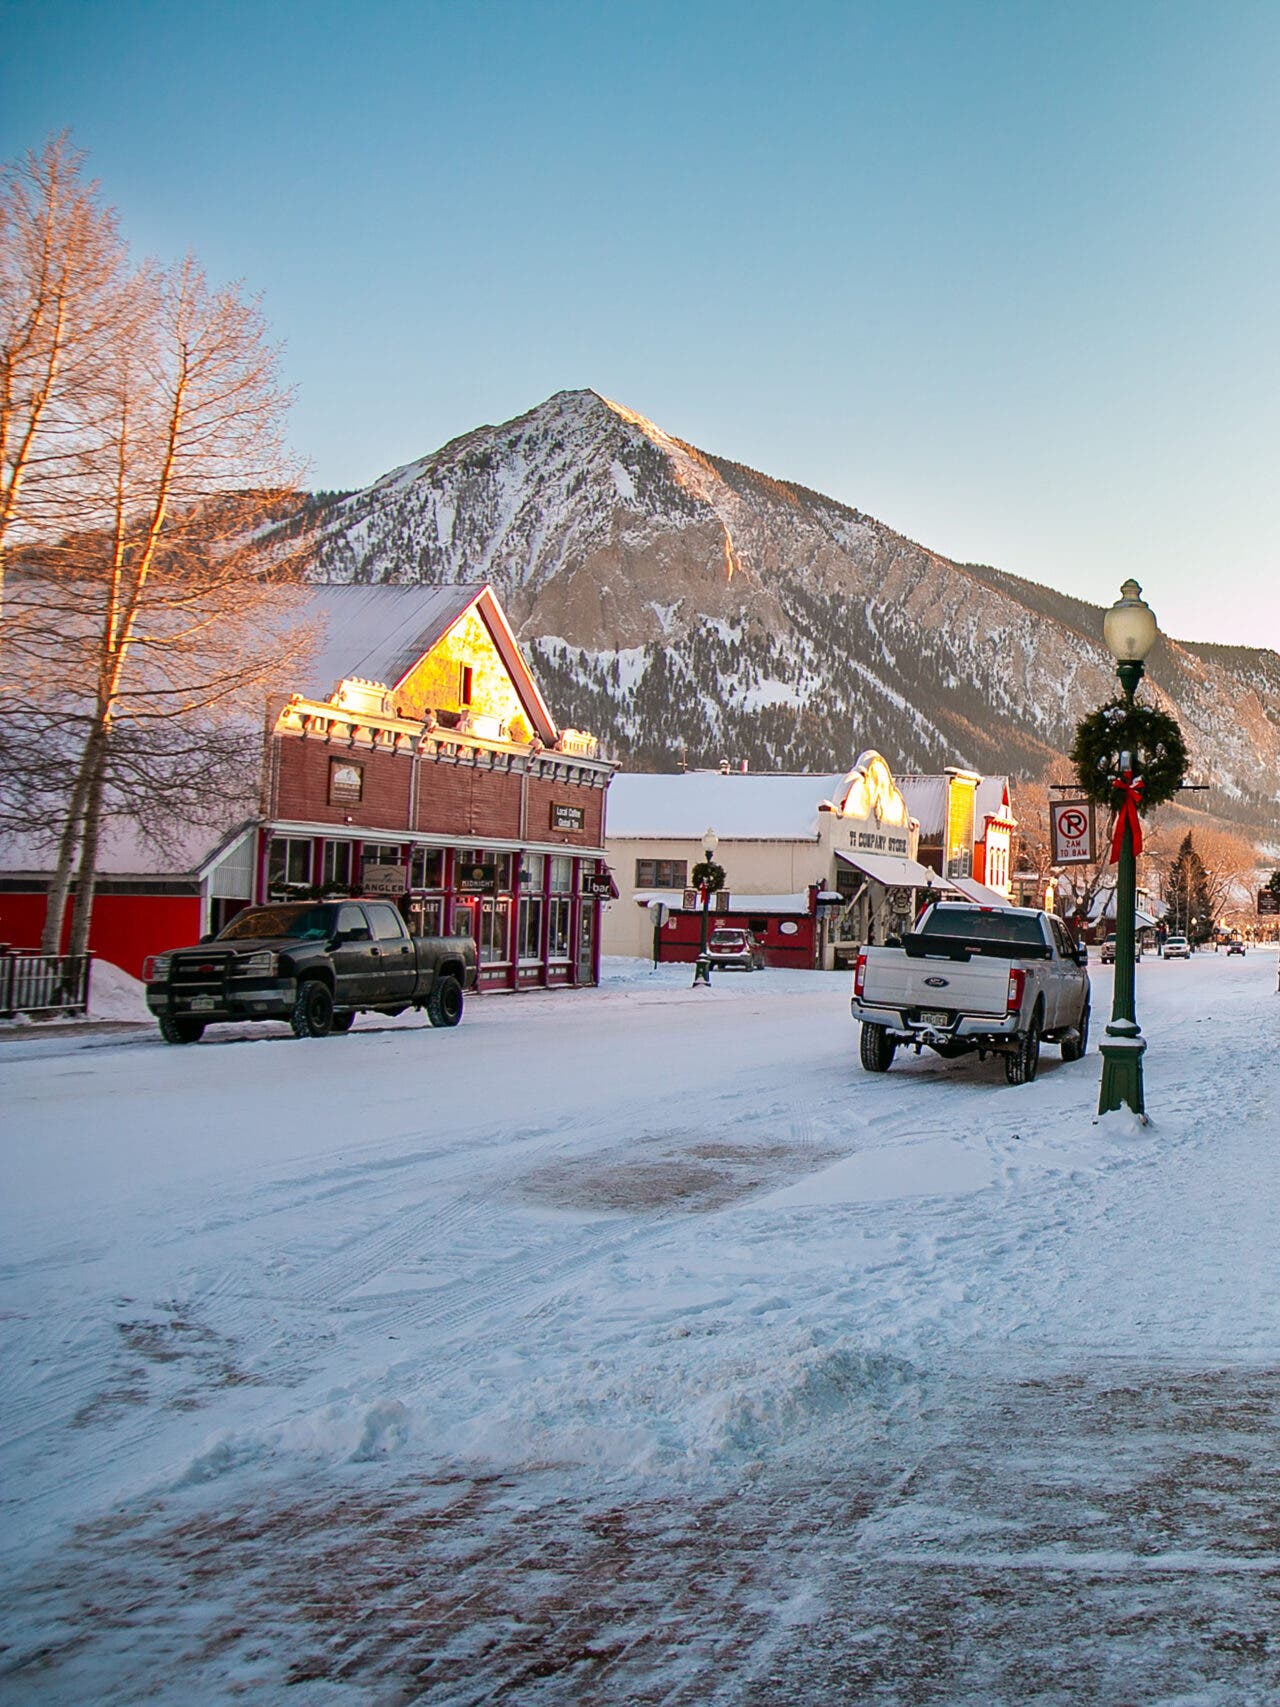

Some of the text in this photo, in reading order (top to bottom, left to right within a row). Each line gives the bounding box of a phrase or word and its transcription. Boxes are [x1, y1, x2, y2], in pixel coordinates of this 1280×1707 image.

[858, 832, 887, 851] COMPANY
[364, 882, 405, 893] ANGLER
[461, 880, 495, 888] MIDNIGHT
